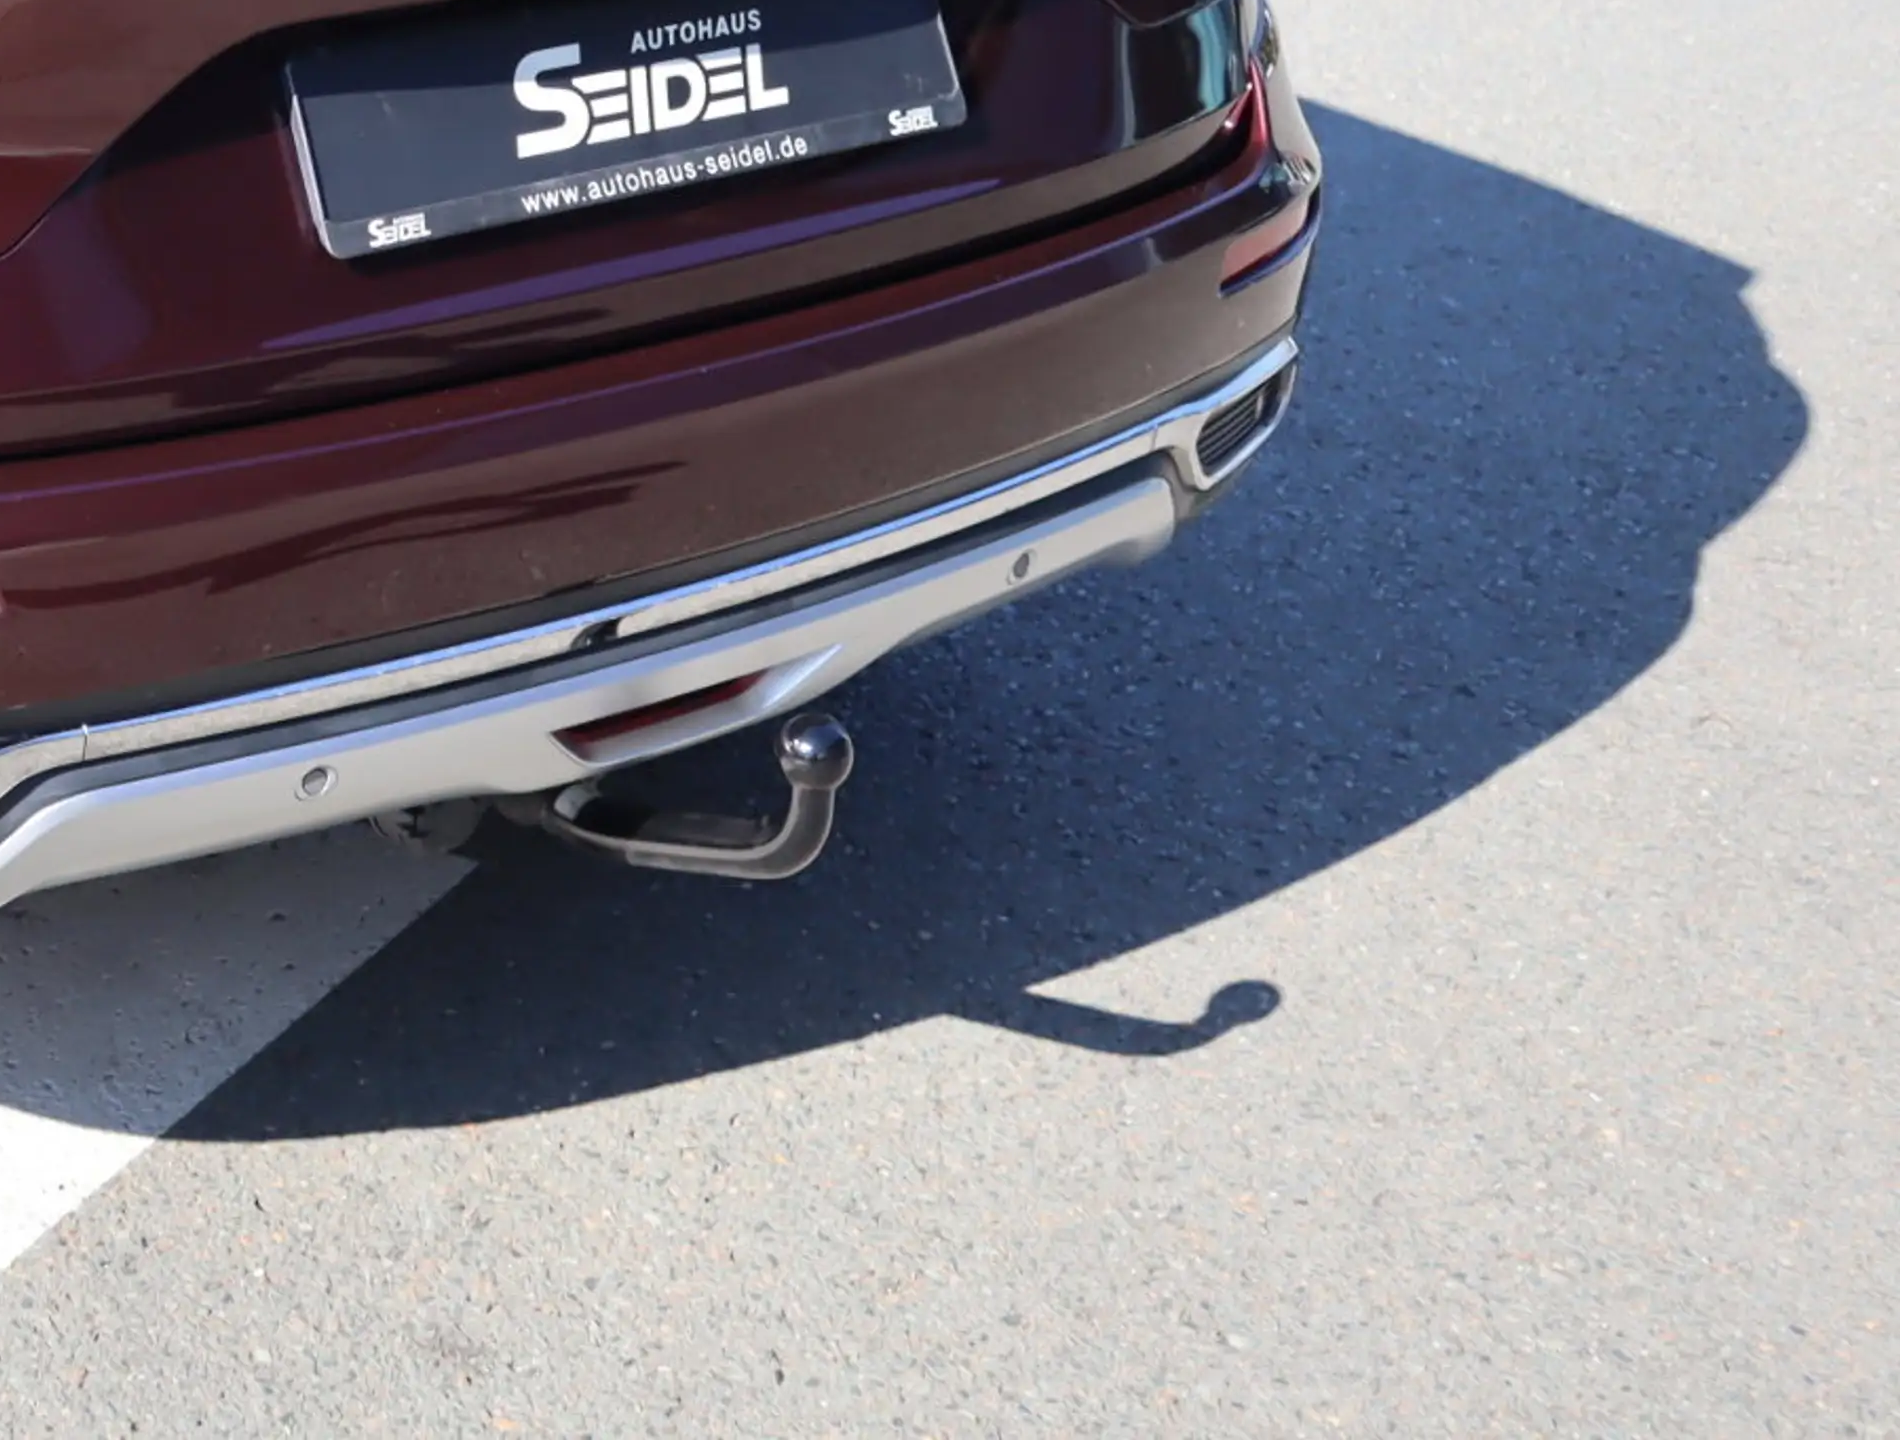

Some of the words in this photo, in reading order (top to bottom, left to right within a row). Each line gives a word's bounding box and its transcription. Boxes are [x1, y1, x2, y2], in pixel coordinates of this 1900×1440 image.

[631, 8, 762, 54] AUTOHAUS
[513, 42, 790, 160] SEIDEL
[521, 134, 808, 214] www.autohaus-seidel.de
